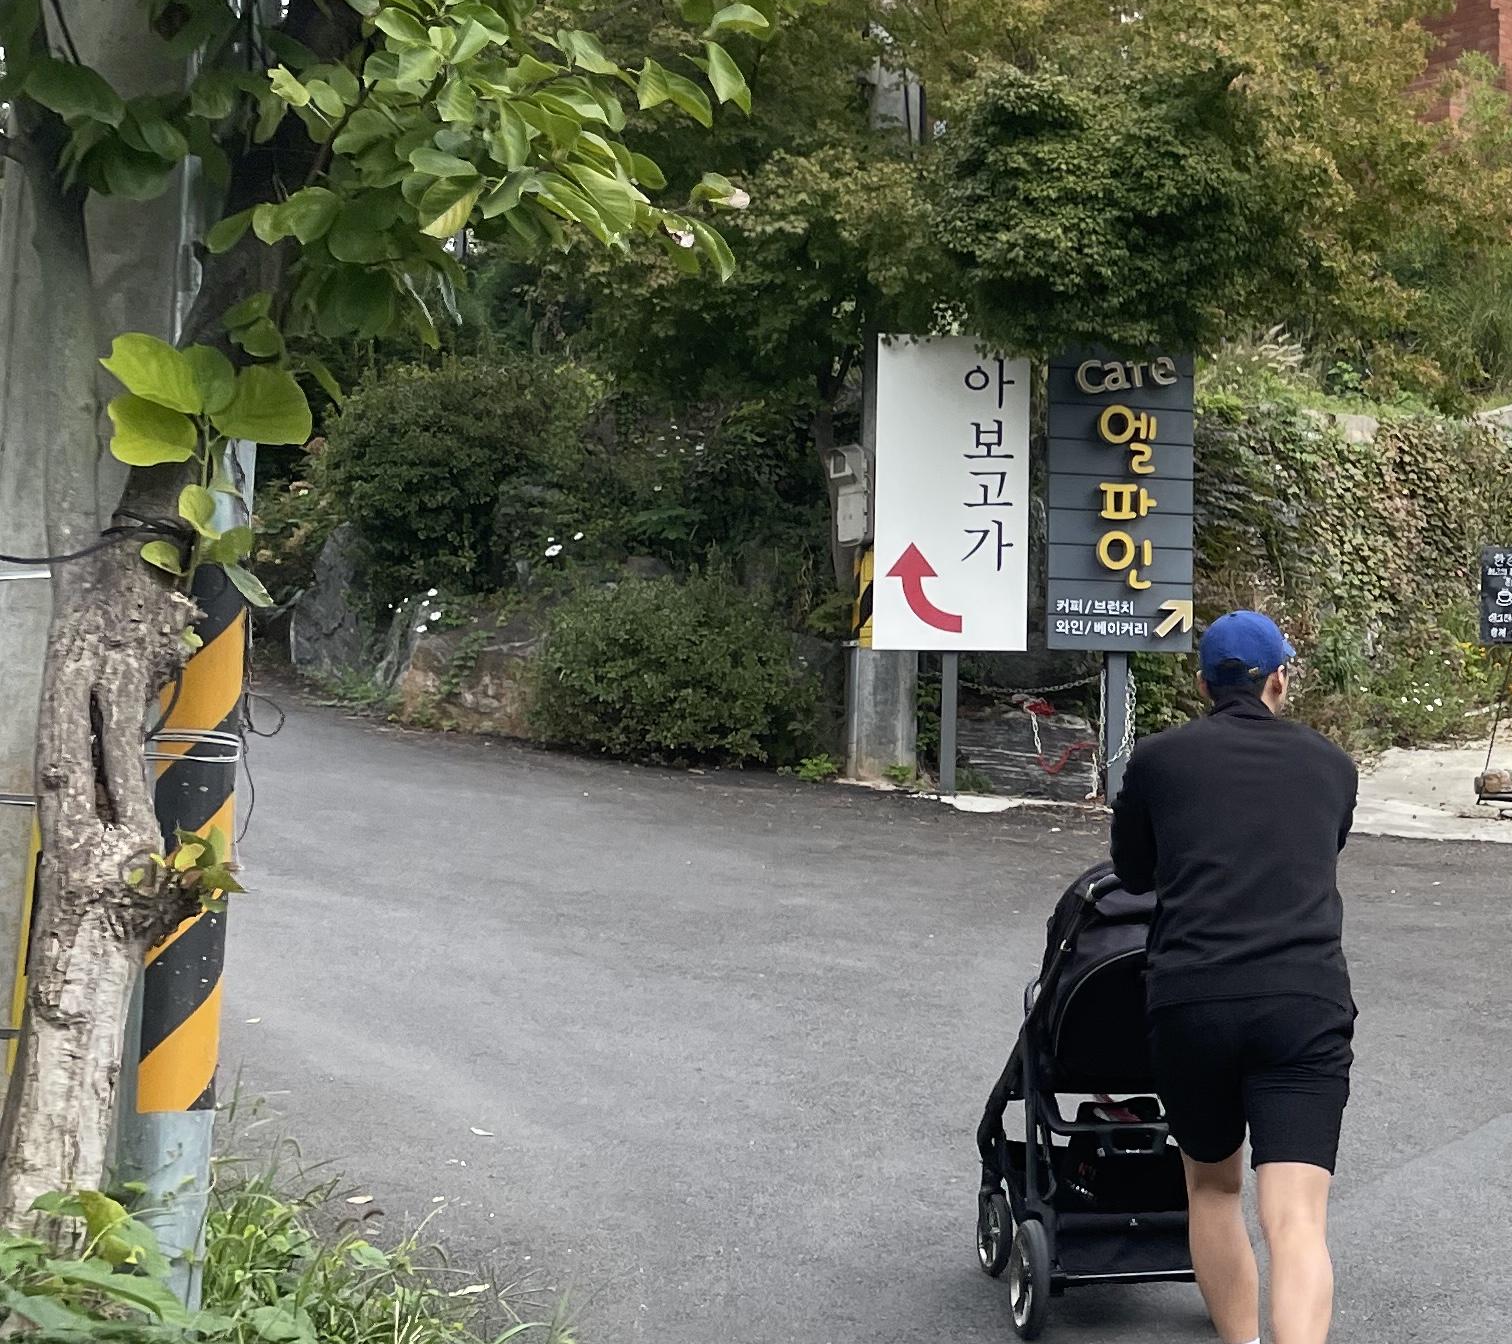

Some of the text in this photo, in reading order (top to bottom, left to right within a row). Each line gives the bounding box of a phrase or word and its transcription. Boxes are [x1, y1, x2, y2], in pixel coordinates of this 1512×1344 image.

[961, 358, 1015, 571] 아보고가
[1097, 404, 1158, 591] 엘파인
[1055, 619, 1148, 637] 와인/베이커리
[1056, 599, 1134, 616] 커피/브런치
